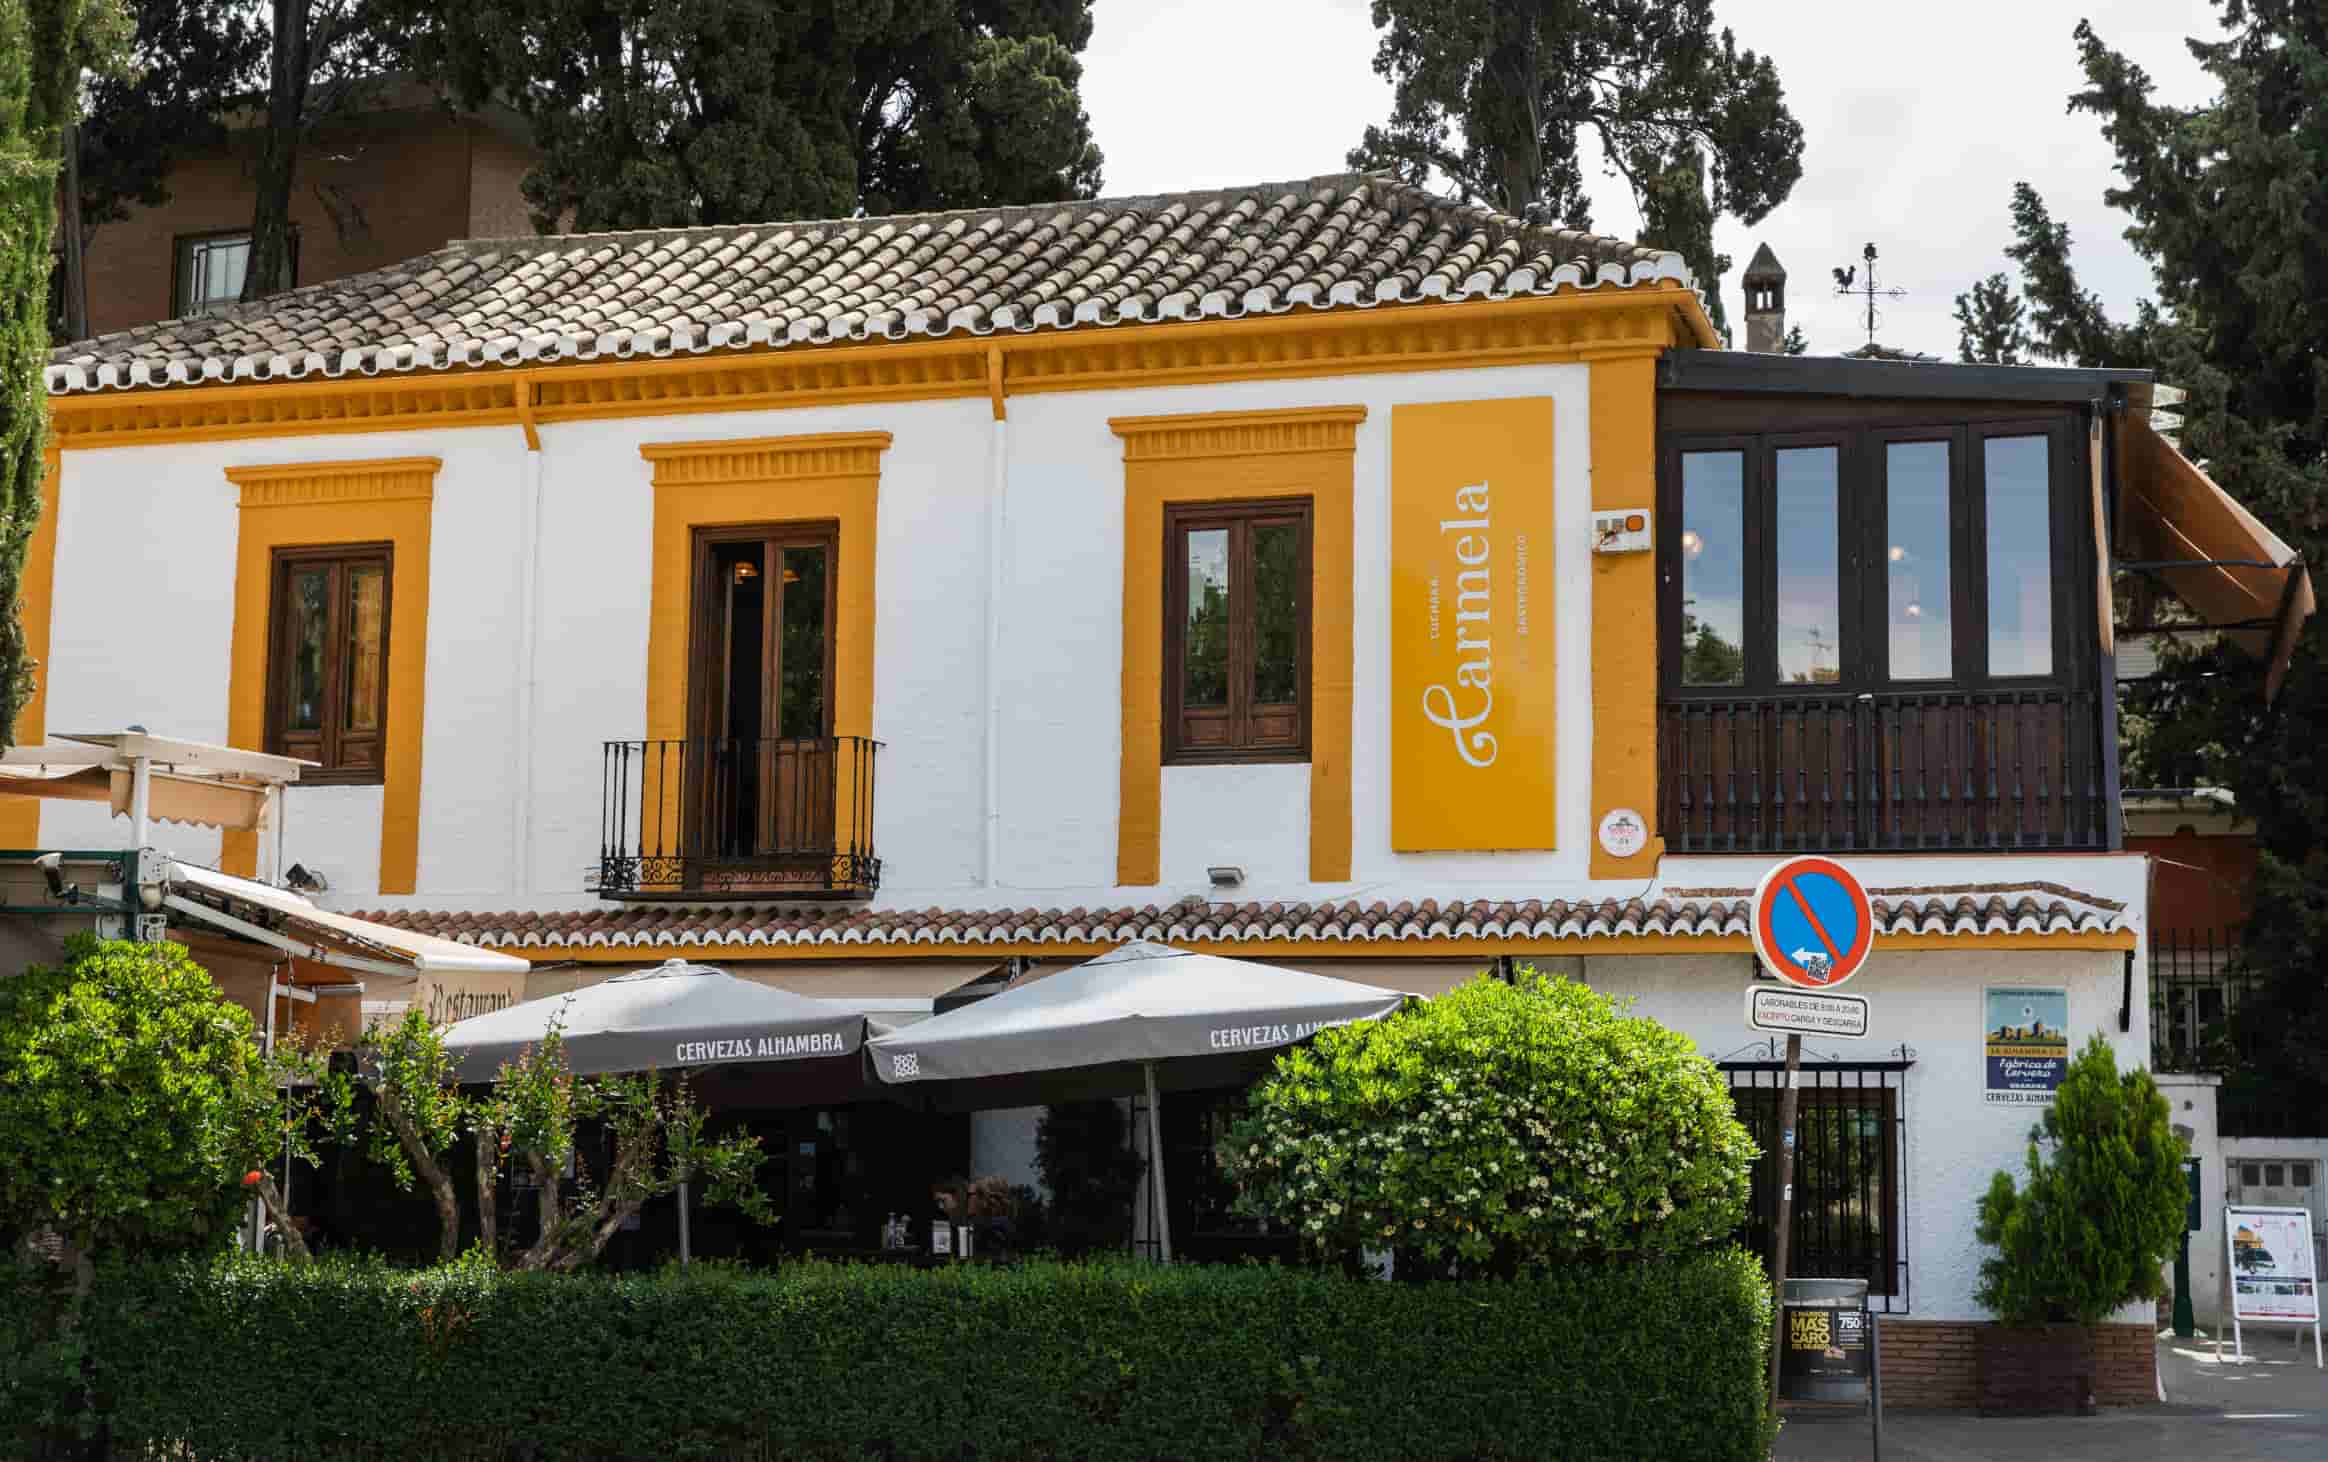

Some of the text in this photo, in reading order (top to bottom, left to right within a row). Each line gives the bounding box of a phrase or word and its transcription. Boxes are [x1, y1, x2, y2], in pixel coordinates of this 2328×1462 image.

[1423, 480, 1498, 768] Carmela
[676, 1032, 843, 1062] CERVEZAS ALHAMBRA
[1209, 1024, 1289, 1048] CERVEZAS
[1791, 1331, 1831, 1344] CARO
